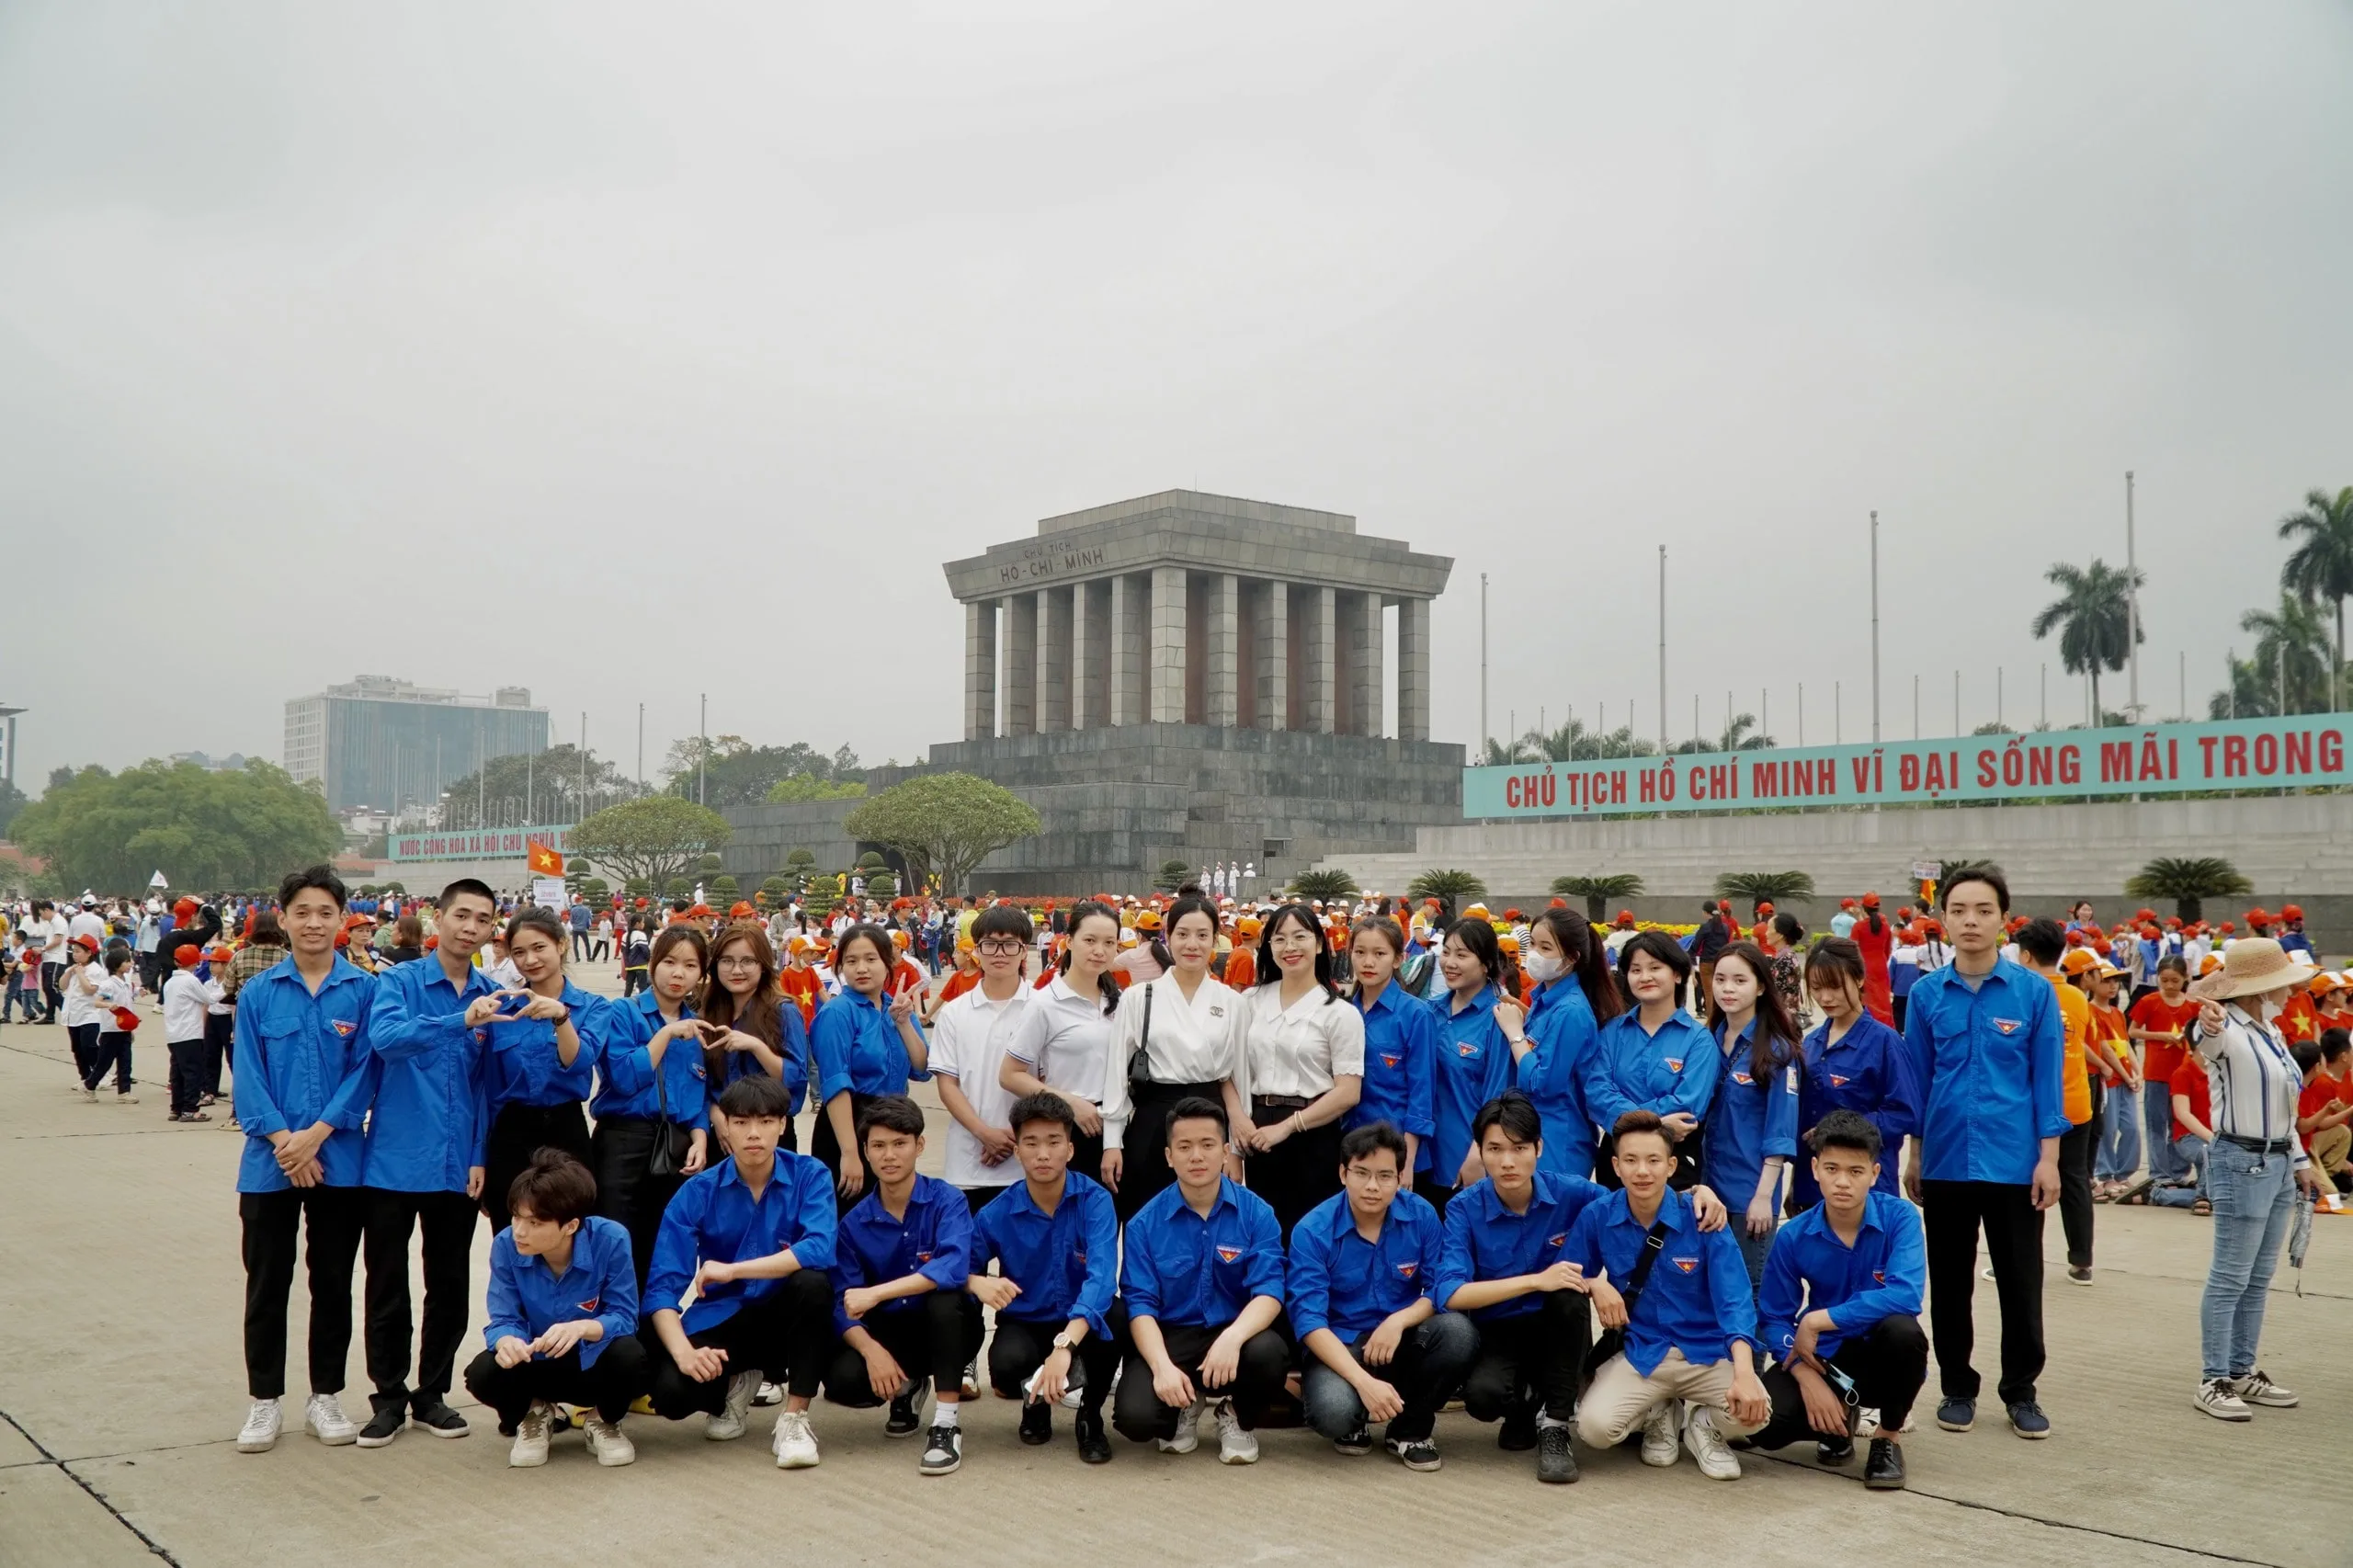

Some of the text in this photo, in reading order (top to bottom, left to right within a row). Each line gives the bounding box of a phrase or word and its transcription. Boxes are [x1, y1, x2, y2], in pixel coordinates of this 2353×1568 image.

[1506, 729, 2344, 812] CHỦ TỊCH HỒ CHÍ MINH VĨ ĐẠI SỐNG MÃI TRONG
